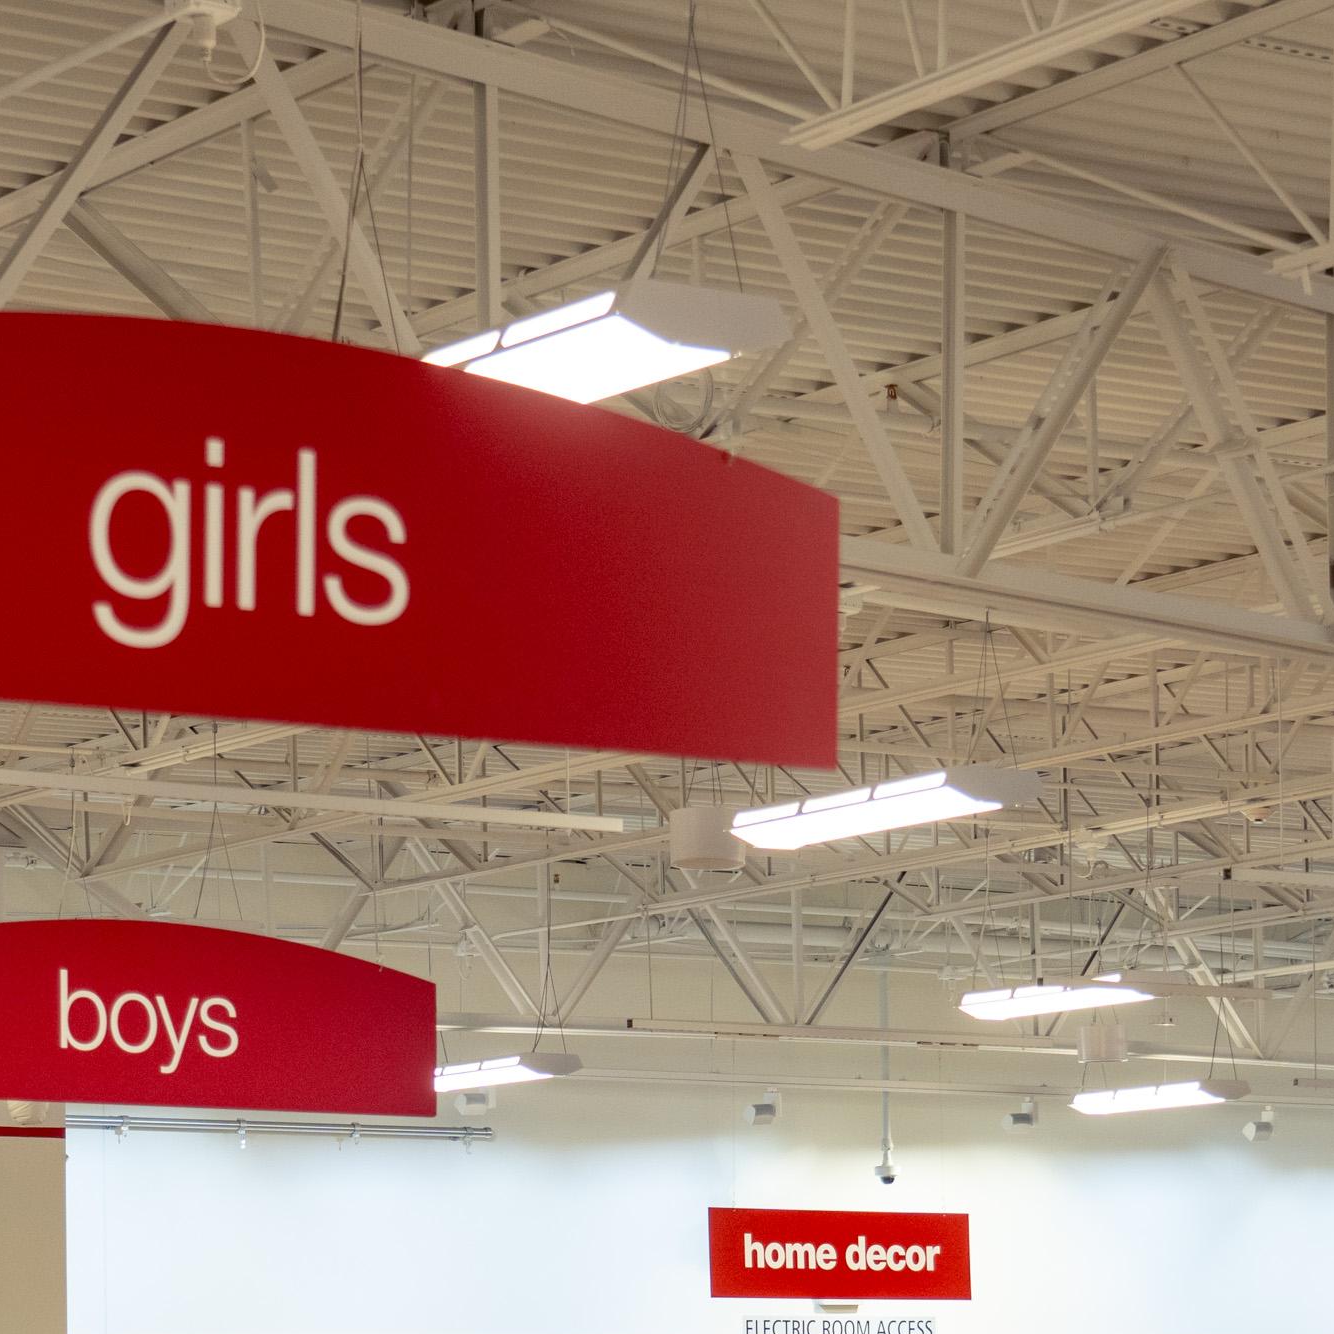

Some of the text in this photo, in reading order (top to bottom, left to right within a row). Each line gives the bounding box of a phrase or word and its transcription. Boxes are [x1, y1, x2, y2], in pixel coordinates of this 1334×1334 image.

[90, 438, 410, 648] girls
[58, 967, 240, 1075] boys
[743, 1232, 941, 1272] home decor
